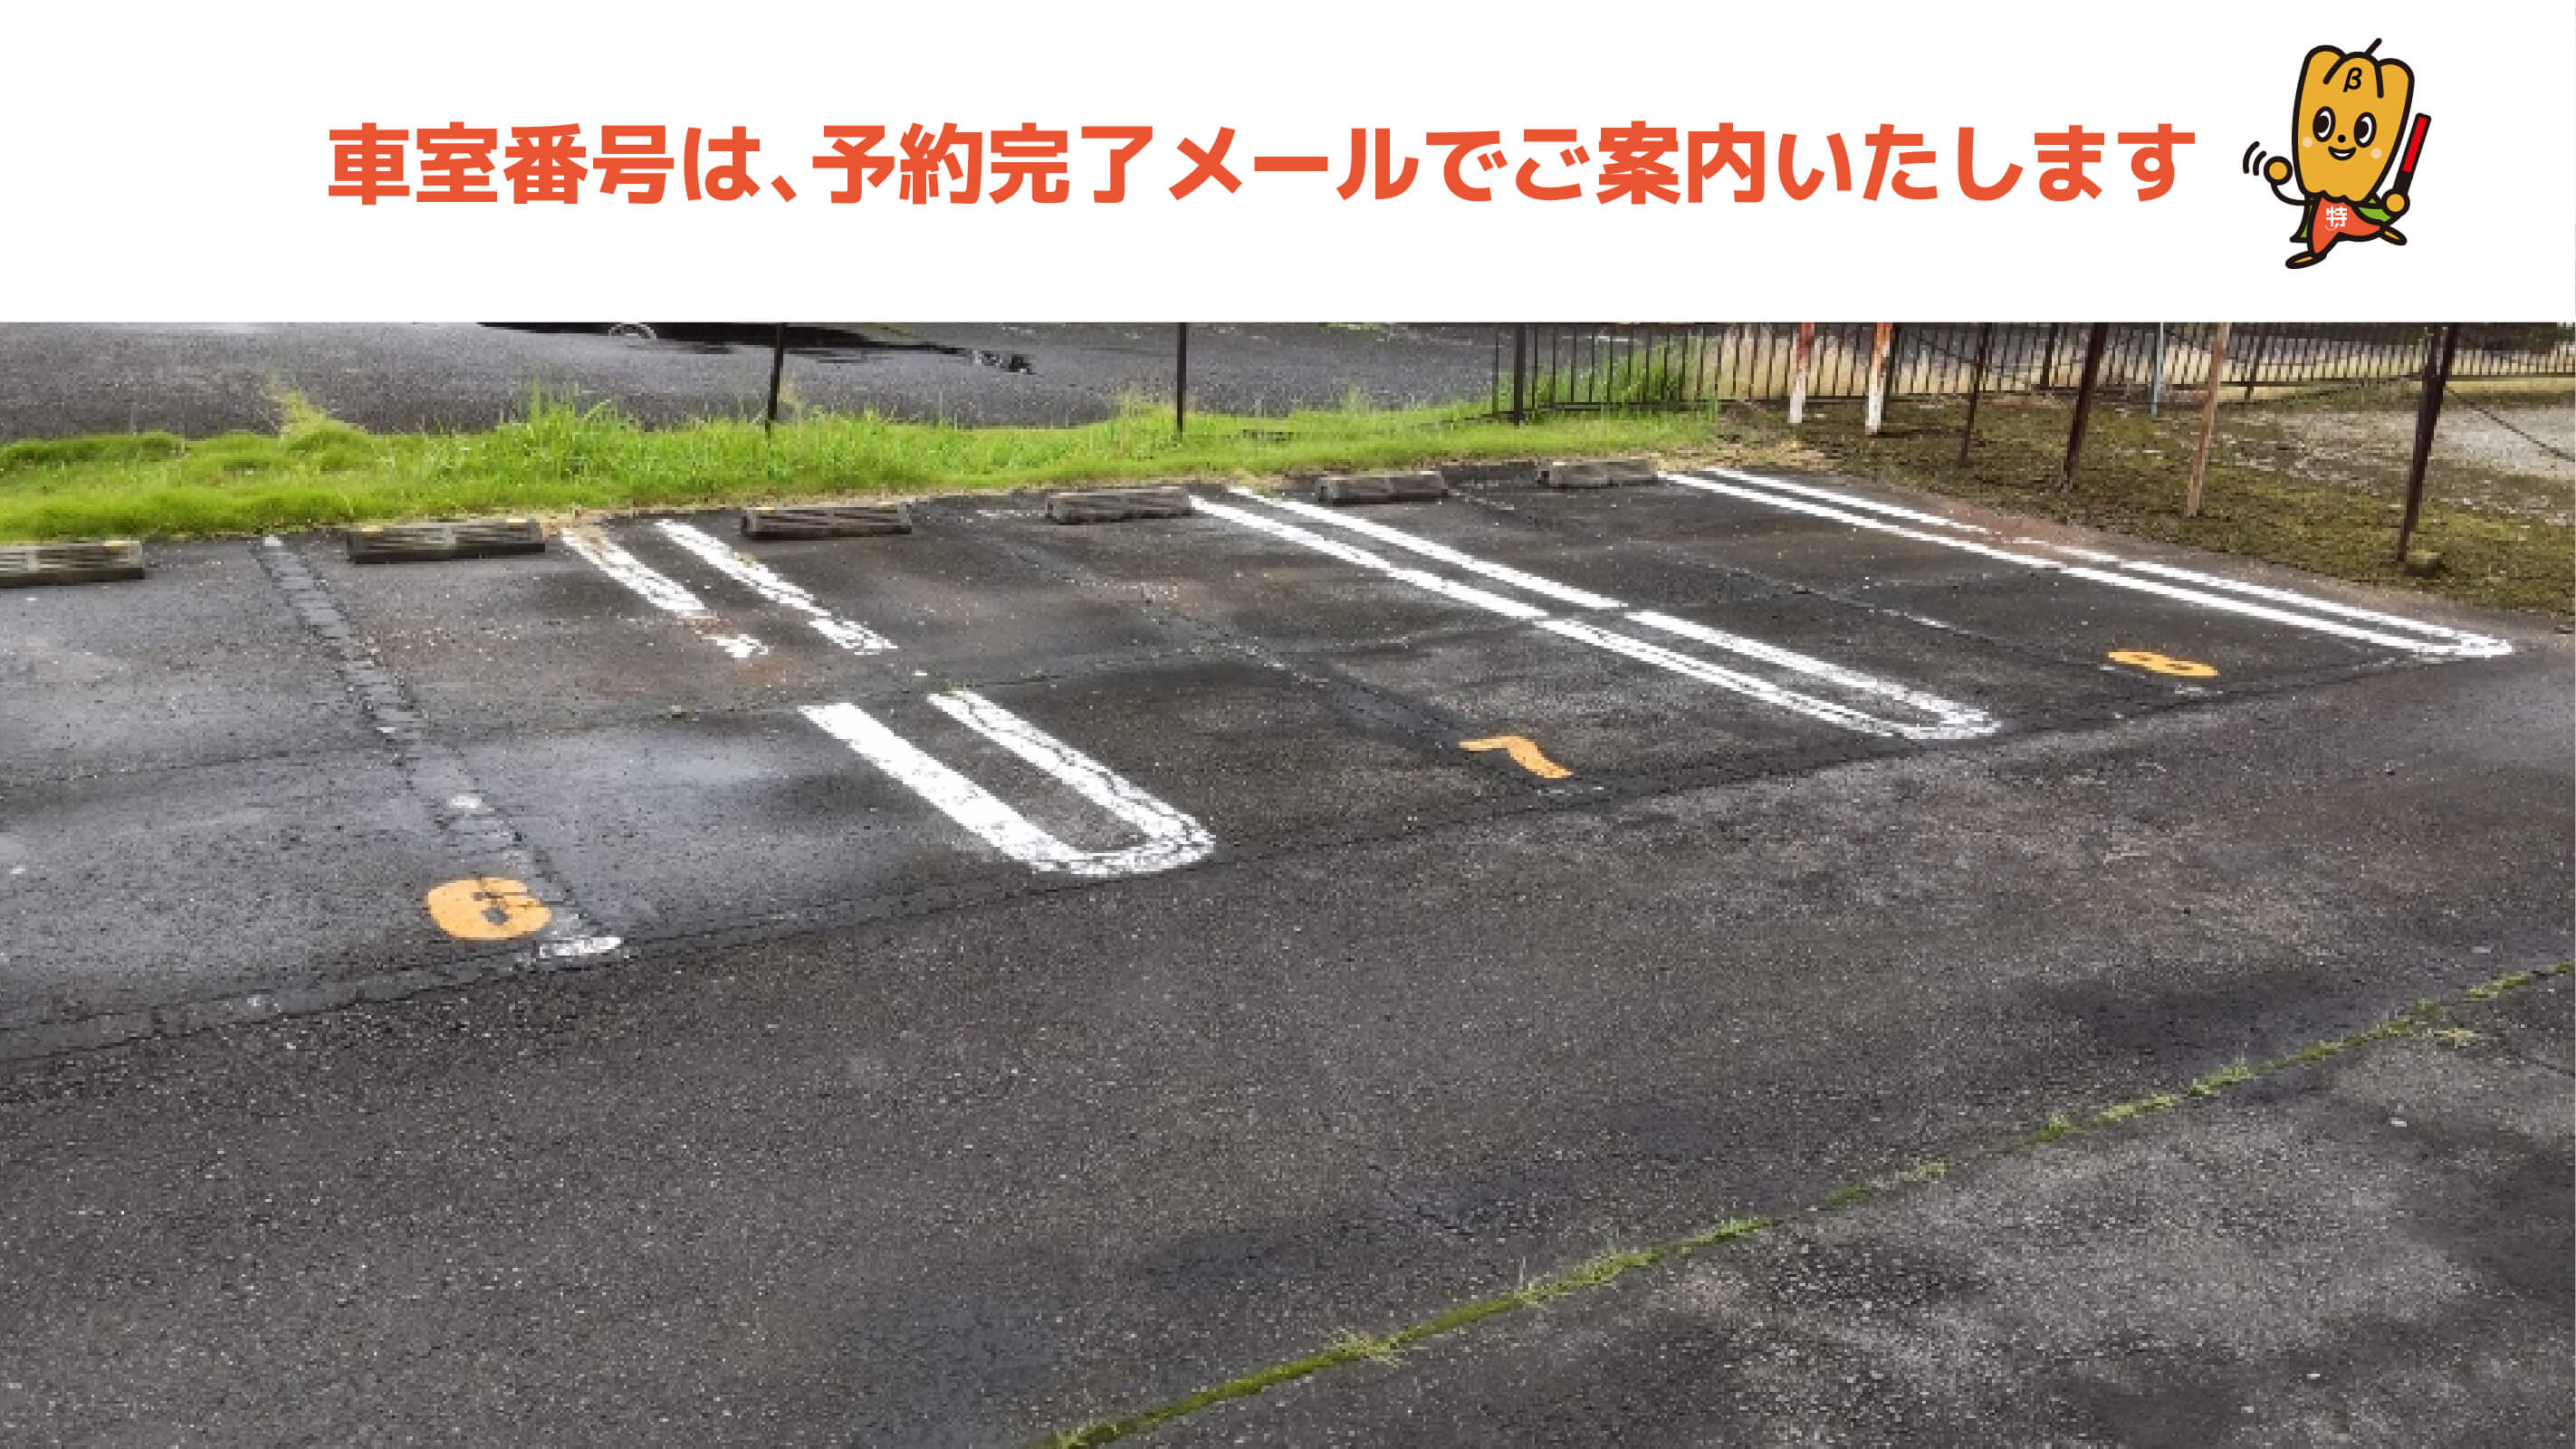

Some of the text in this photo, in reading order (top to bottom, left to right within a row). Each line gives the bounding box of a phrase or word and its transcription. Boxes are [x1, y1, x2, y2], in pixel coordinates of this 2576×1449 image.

[2107, 649, 2219, 677] 8
[1458, 735, 1574, 779] 7
[426, 877, 551, 941] 6
